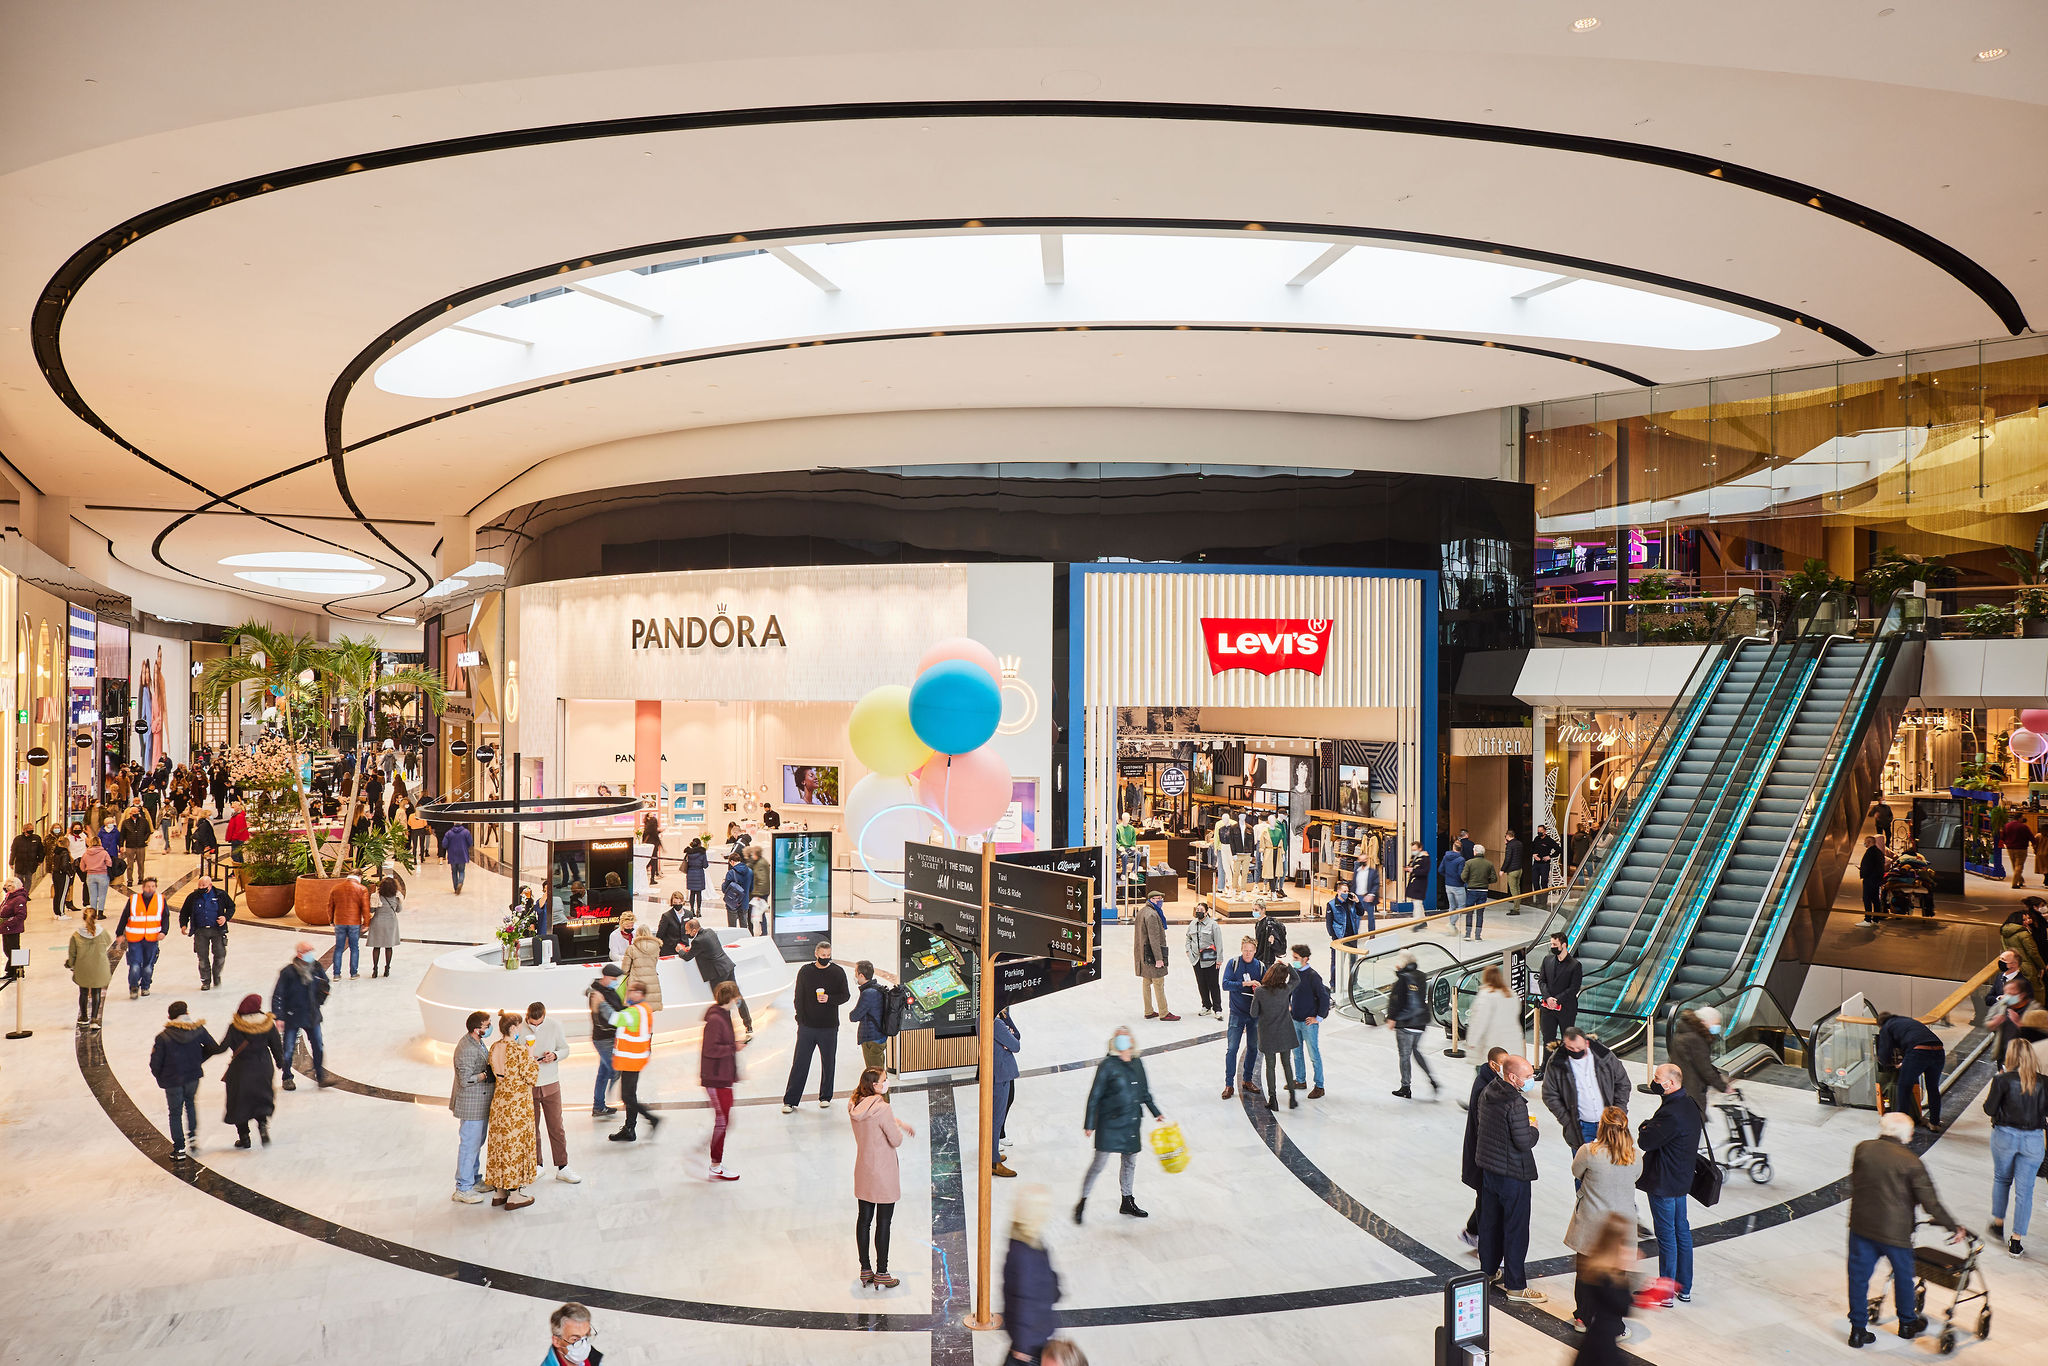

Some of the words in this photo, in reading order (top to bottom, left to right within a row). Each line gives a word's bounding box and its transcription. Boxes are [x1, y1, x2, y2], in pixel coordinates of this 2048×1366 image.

[632, 614, 787, 650] PANDORA
[1478, 737, 1521, 754] liften
[592, 842, 628, 850] Reception
[787, 841, 817, 849] TIRISI
[921, 861, 939, 870] SECRET
[949, 862, 958, 872] THE
[959, 864, 974, 874] STING
[997, 873, 1008, 881] Taxi
[956, 880, 974, 892] HEMA
[997, 886, 1007, 896] Kiss
[1011, 889, 1021, 898] Ride
[959, 910, 975, 923] Parking
[997, 913, 1014, 926] Parking
[955, 923, 968, 935] Ingang
[997, 927, 1012, 939] Ingang
[1011, 930, 1016, 939] A
[1004, 968, 1025, 978] Parking
[1004, 982, 1022, 992] Ingang
